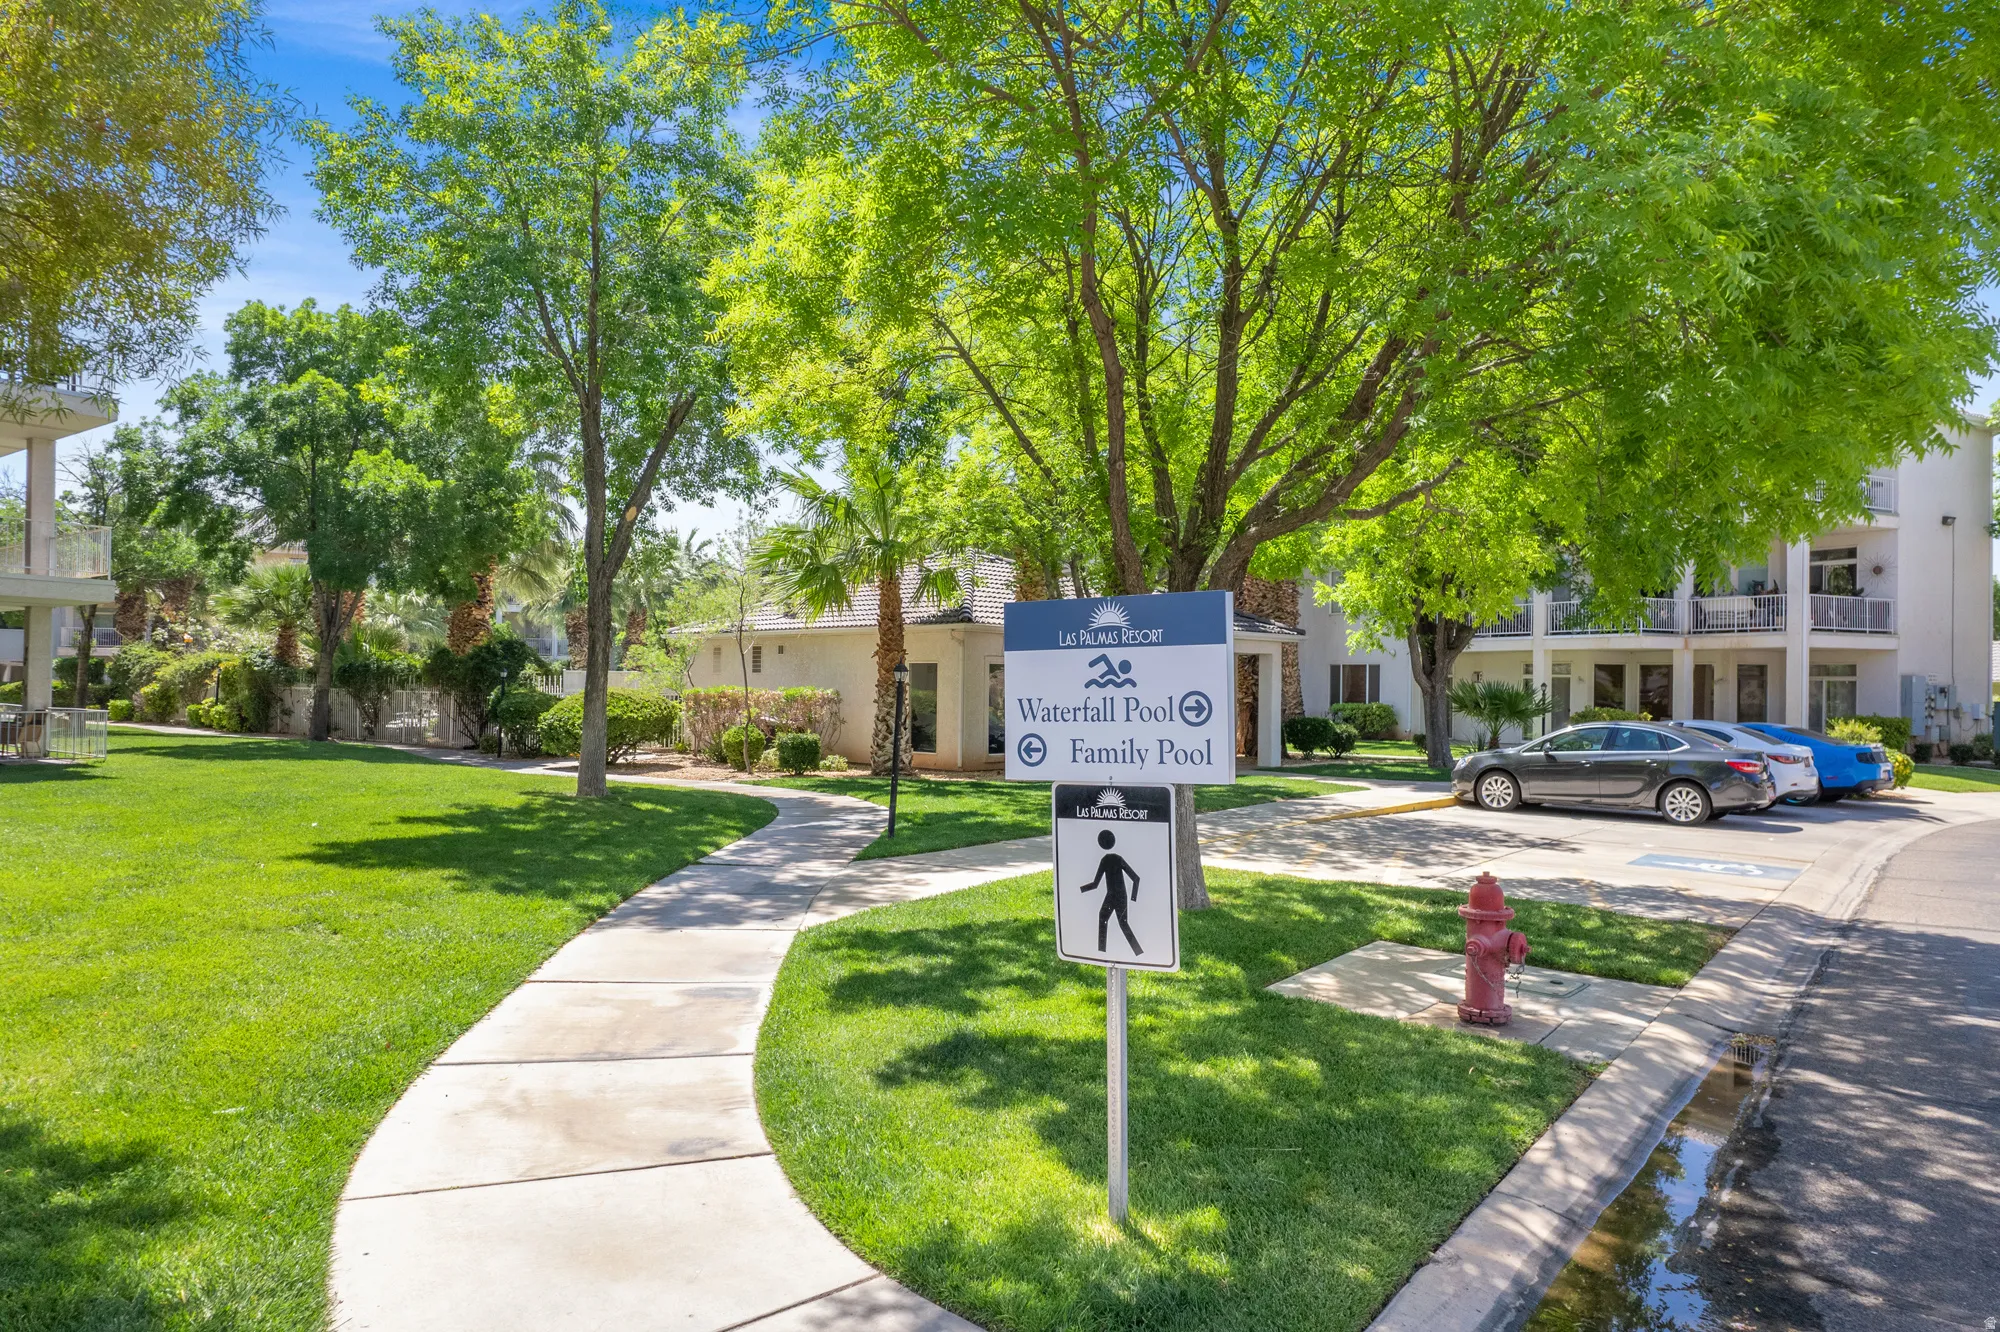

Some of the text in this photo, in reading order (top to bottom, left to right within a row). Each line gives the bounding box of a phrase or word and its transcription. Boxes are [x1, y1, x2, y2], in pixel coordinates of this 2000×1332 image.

[1059, 628, 1164, 646] LAS PALMAS RESORT
[1017, 695, 1176, 723] Waterfall Pool
[1070, 738, 1214, 771] Family Pool
[1076, 805, 1149, 820] LAS PALMAS RESORT
